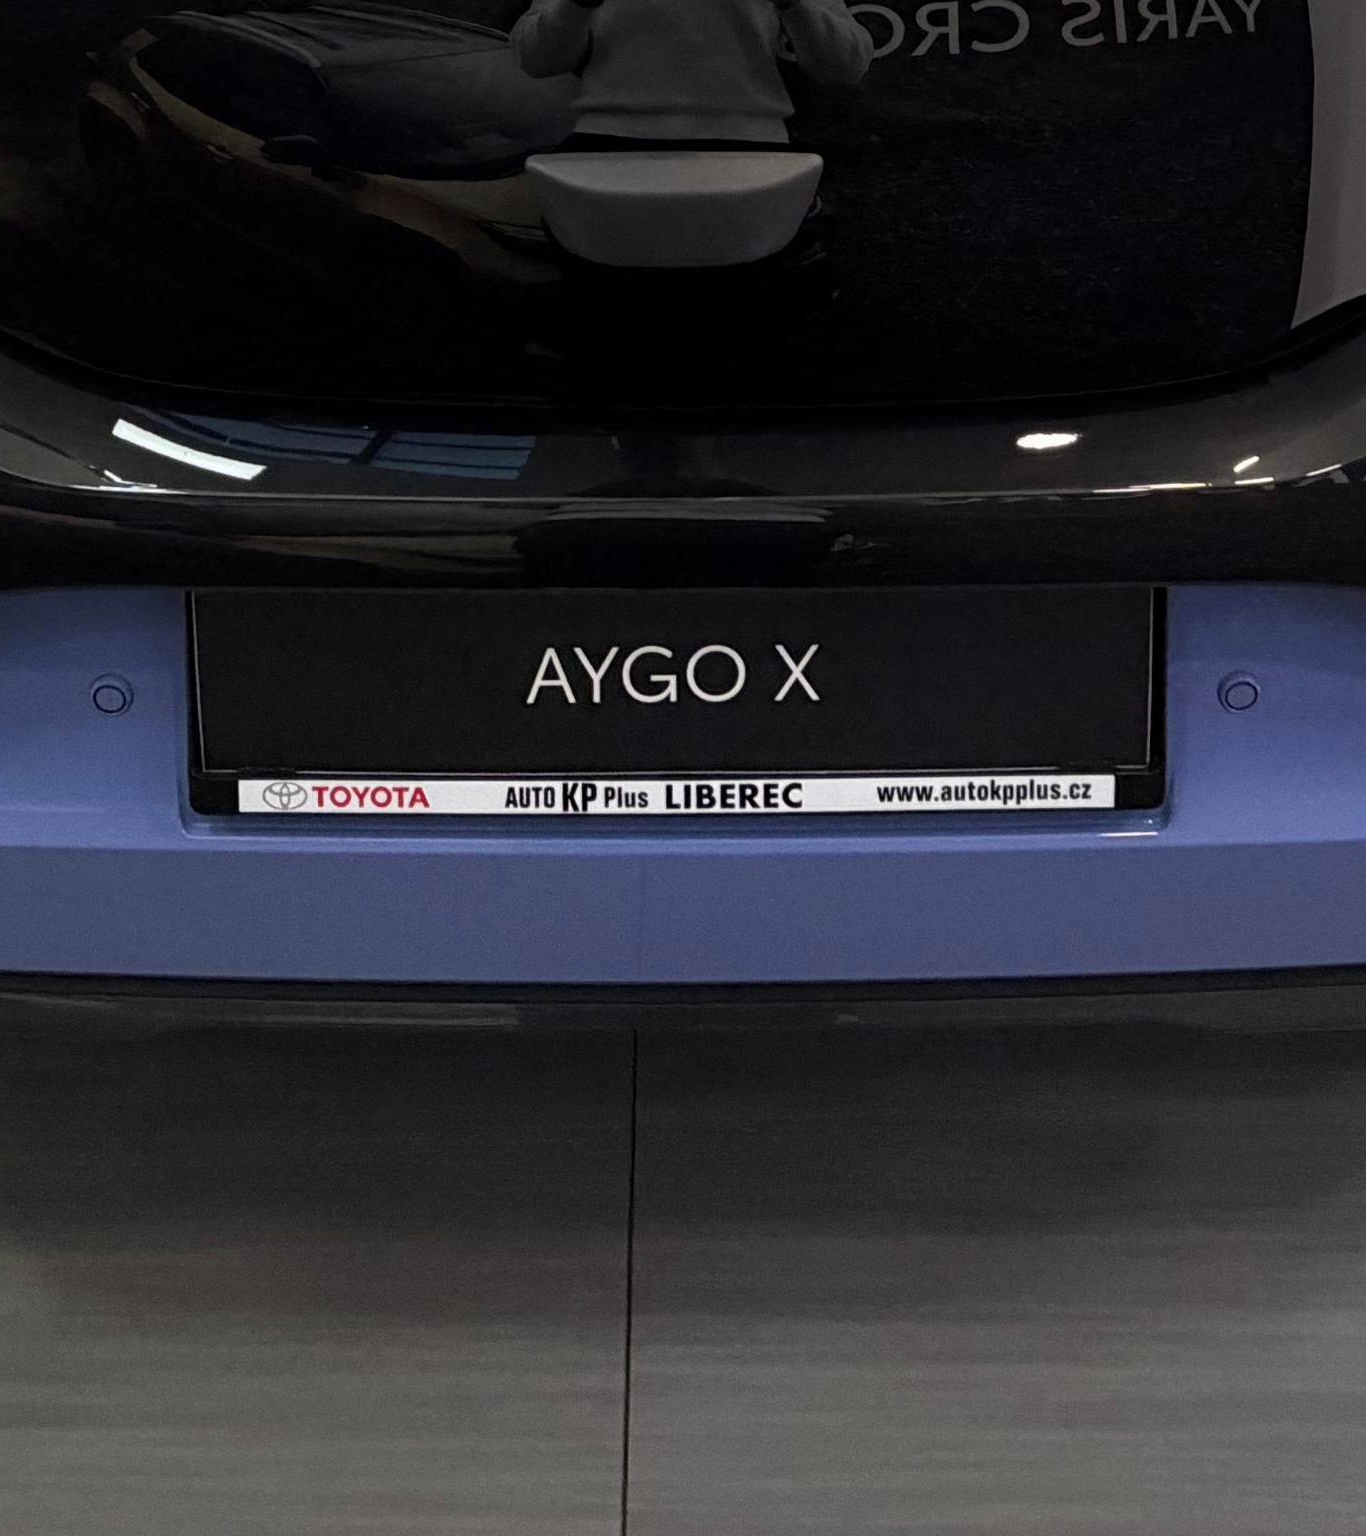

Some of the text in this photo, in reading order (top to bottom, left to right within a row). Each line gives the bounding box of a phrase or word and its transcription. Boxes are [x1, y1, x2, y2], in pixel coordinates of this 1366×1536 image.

[527, 643, 822, 706] AYGO X
[312, 779, 1093, 813] TOYOTA AUTO KP Plus LIBEREC www.autokpplus.cz
